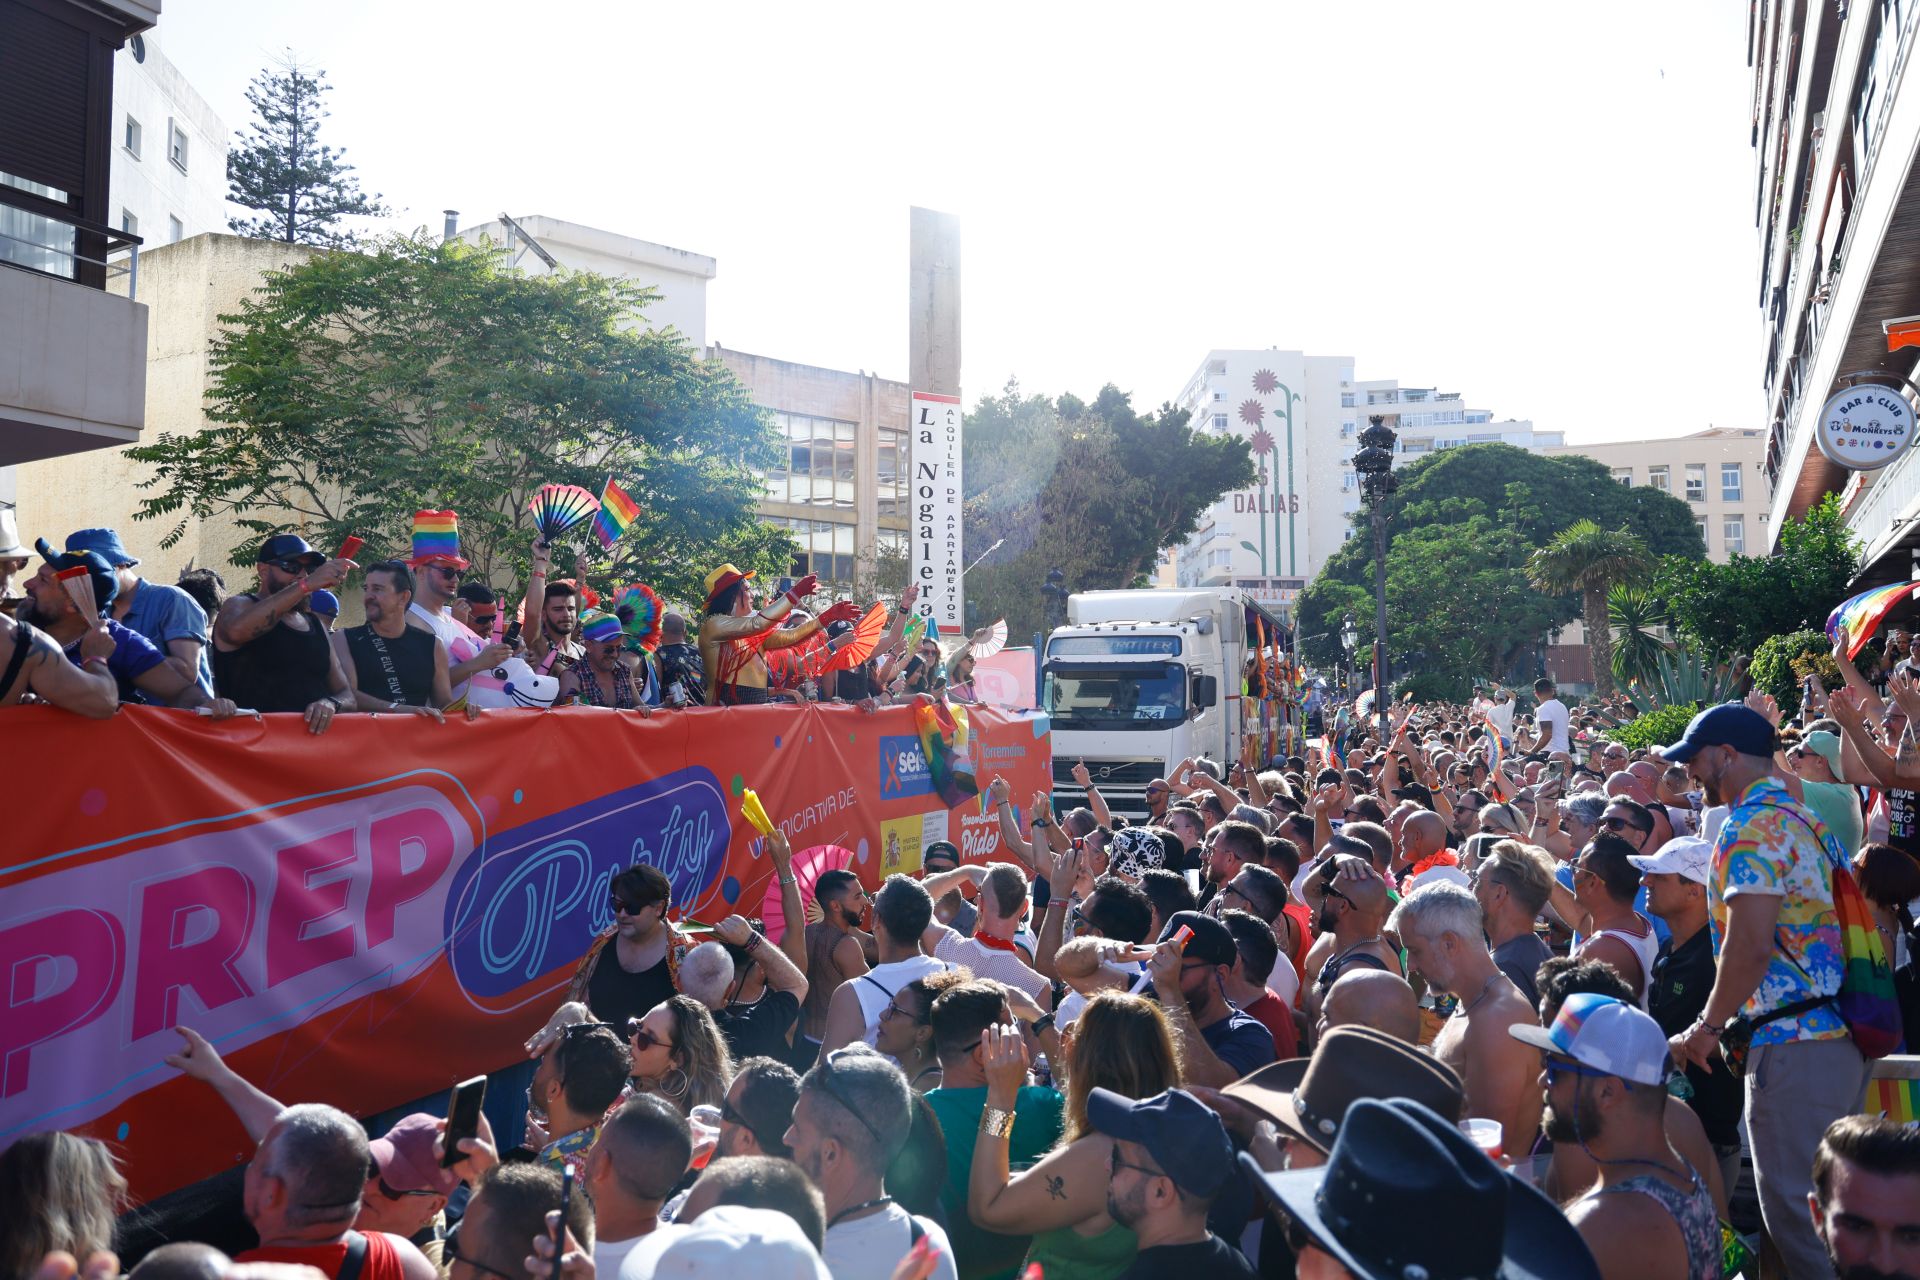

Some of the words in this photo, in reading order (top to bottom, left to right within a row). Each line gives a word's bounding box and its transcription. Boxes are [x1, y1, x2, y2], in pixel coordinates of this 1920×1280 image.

[1840, 397, 1862, 414] BAR
[1866, 396, 1874, 404] &
[1878, 398, 1902, 418] CLUB
[918, 408, 936, 444] La
[946, 408, 956, 478] ALQUILER
[946, 488, 956, 504] DE
[1234, 494, 1299, 514] DALIAS
[916, 462, 938, 617] Nogalera
[946, 515, 956, 620] APARTAMENTOS
[838, 786, 857, 810] DE:
[961, 826, 1000, 860] Pride
[0, 806, 458, 1099] PREP
